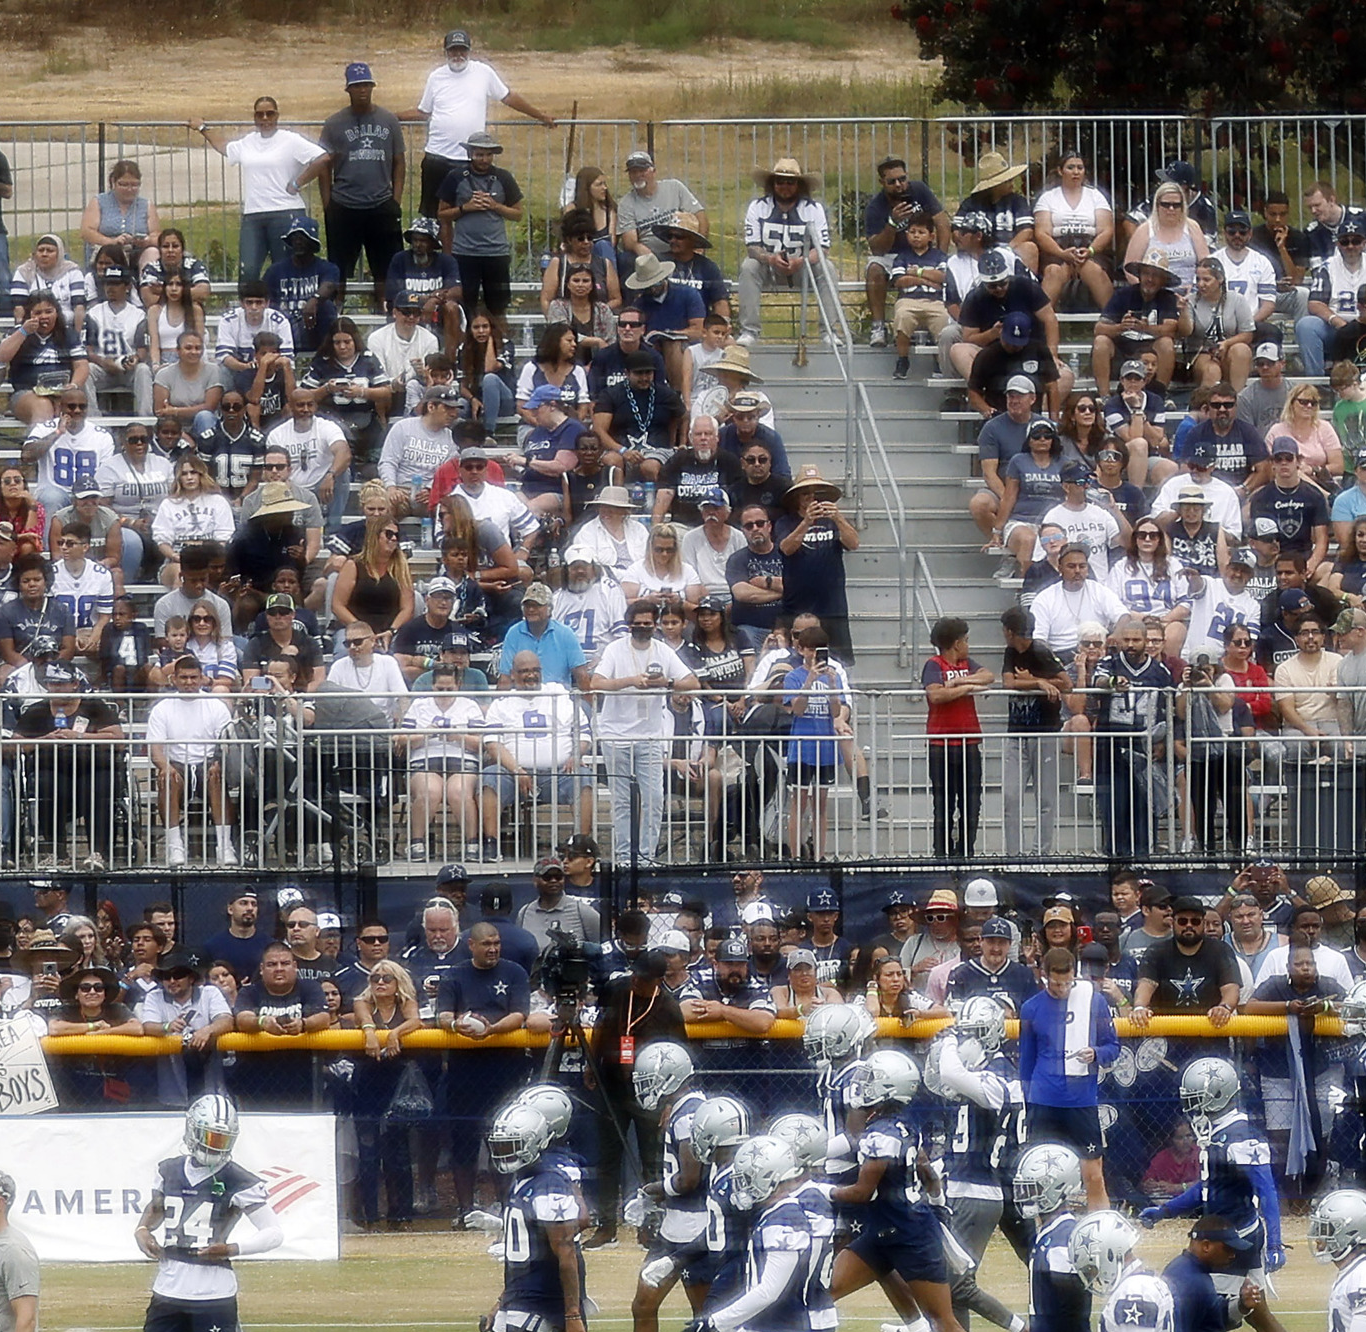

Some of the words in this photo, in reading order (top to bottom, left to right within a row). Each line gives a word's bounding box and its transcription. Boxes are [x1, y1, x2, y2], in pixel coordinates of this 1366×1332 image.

[345, 127, 389, 141] DALLAS
[761, 223, 806, 257] 55
[103, 327, 127, 354] 21
[409, 440, 447, 455] DALLAS
[54, 448, 97, 486] 88
[215, 455, 251, 486] 15
[1275, 499, 1304, 510] Cowboys
[1125, 578, 1170, 612] 94
[119, 637, 135, 663] 4
[953, 1103, 971, 1151] 9
[164, 1195, 214, 1248] 24
